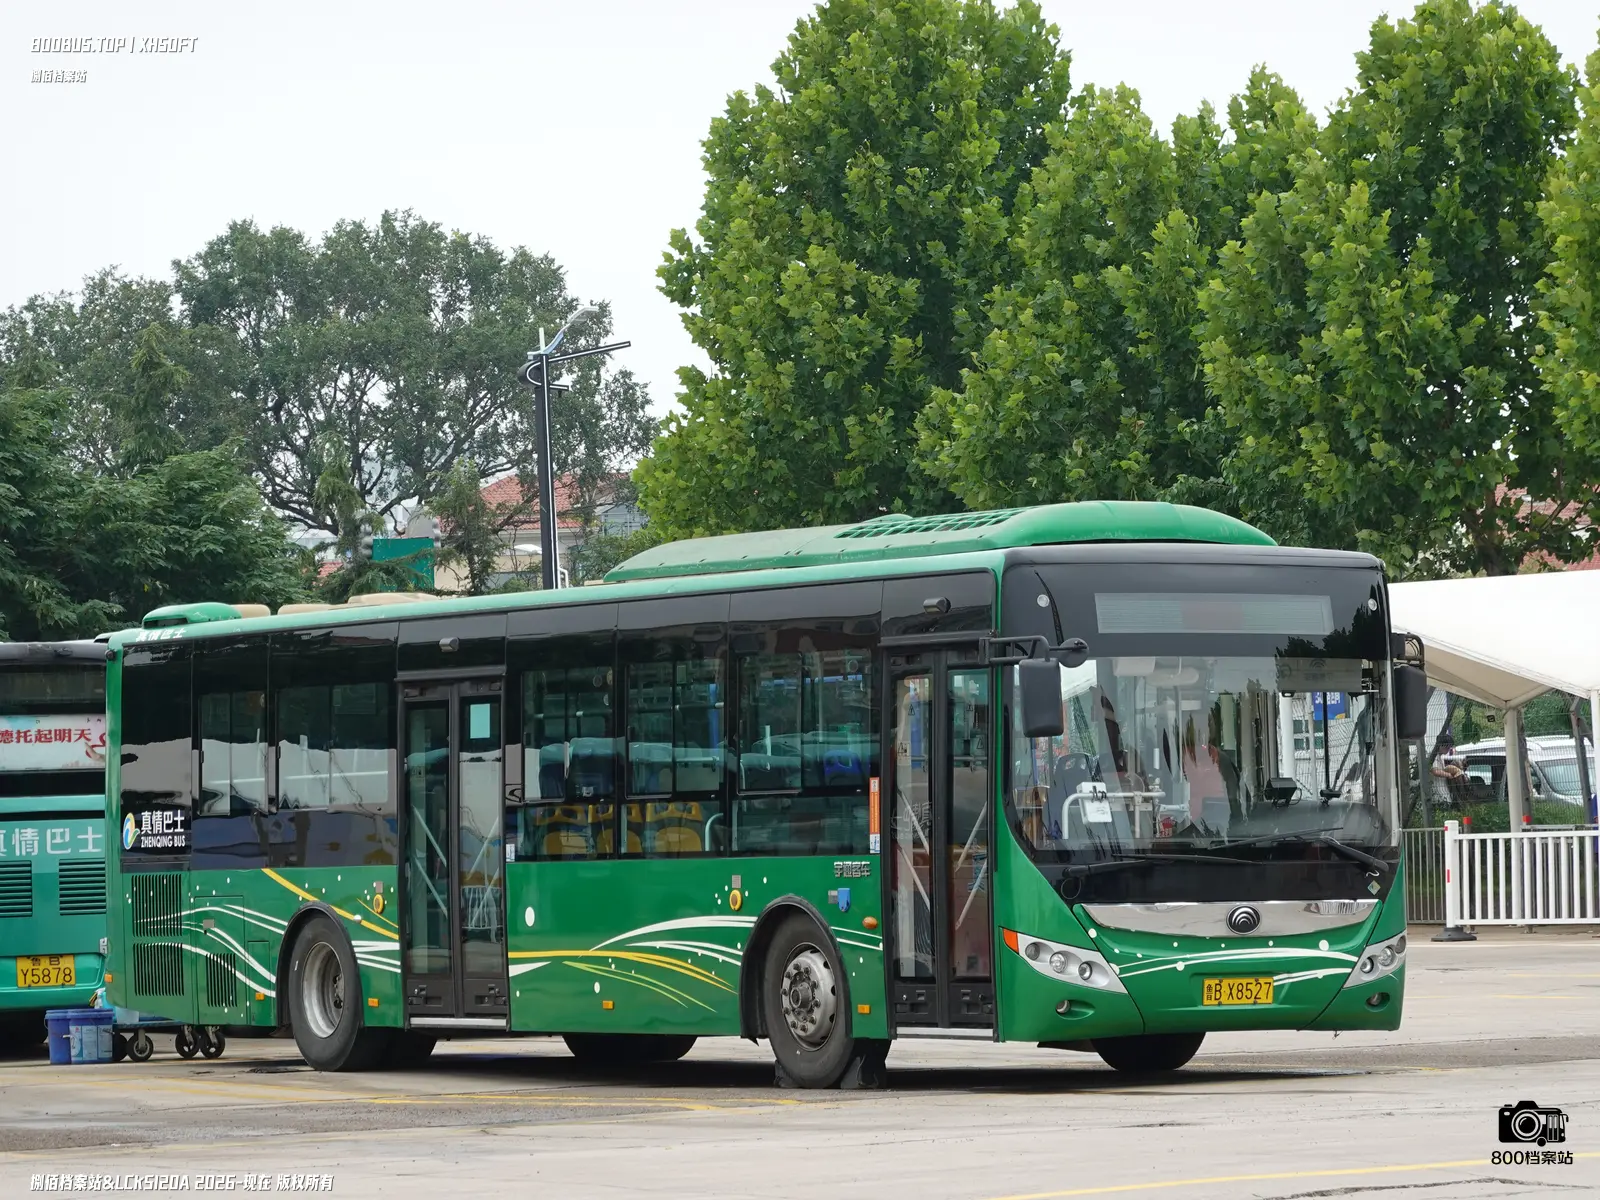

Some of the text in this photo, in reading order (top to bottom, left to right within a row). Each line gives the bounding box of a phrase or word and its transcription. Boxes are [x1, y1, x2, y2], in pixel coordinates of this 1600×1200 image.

[140, 810, 185, 835] 真情巴士
[0, 826, 103, 857] 情巴士
[140, 835, 186, 849] ZHENQING BUS
[834, 861, 871, 878] 宇通客车
[20, 967, 73, 985] Y5878
